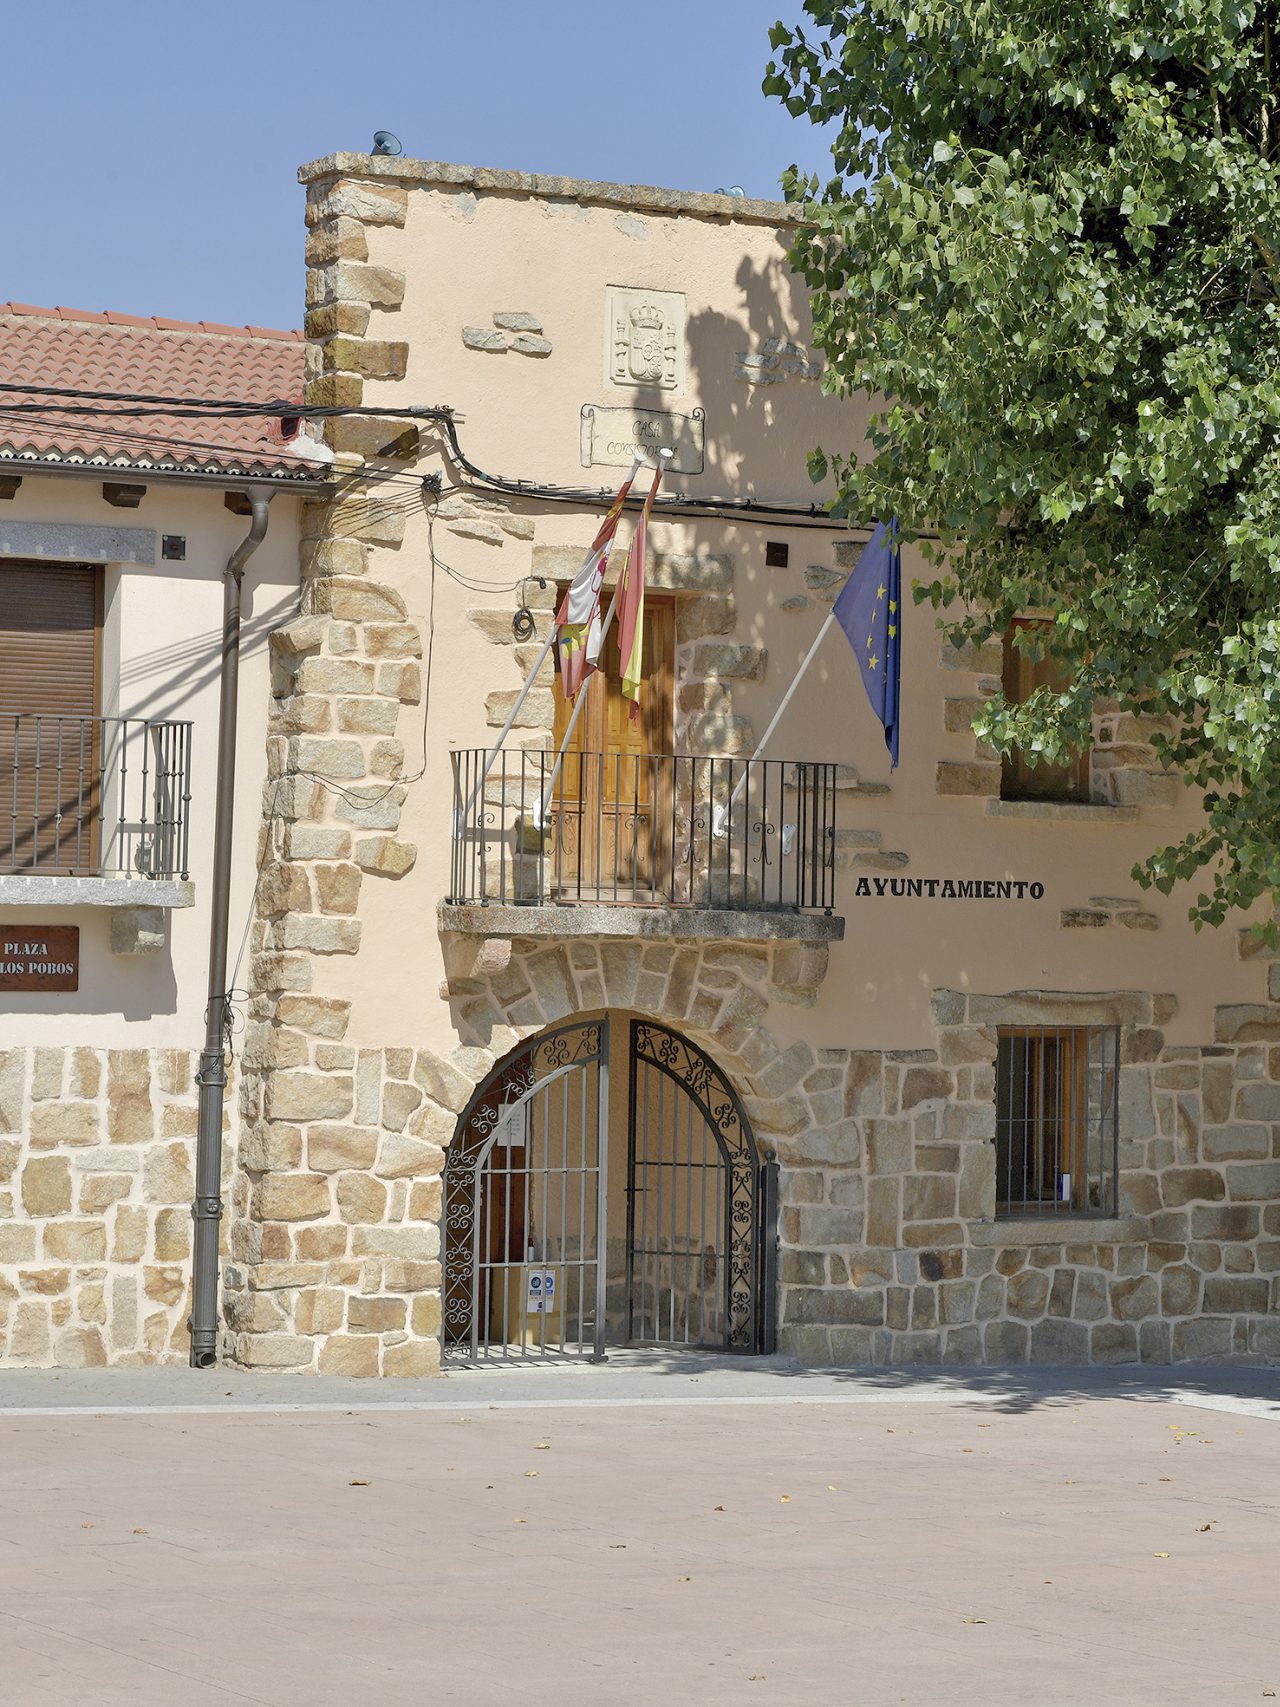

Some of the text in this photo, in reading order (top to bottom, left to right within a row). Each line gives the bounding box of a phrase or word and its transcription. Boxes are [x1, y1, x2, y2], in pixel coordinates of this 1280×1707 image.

[632, 420, 661, 438] CASA
[855, 877, 1045, 900] AYUNTAMIENTO
[4, 943, 48, 955] PLAZA
[0, 962, 74, 974] LOS POBOS
